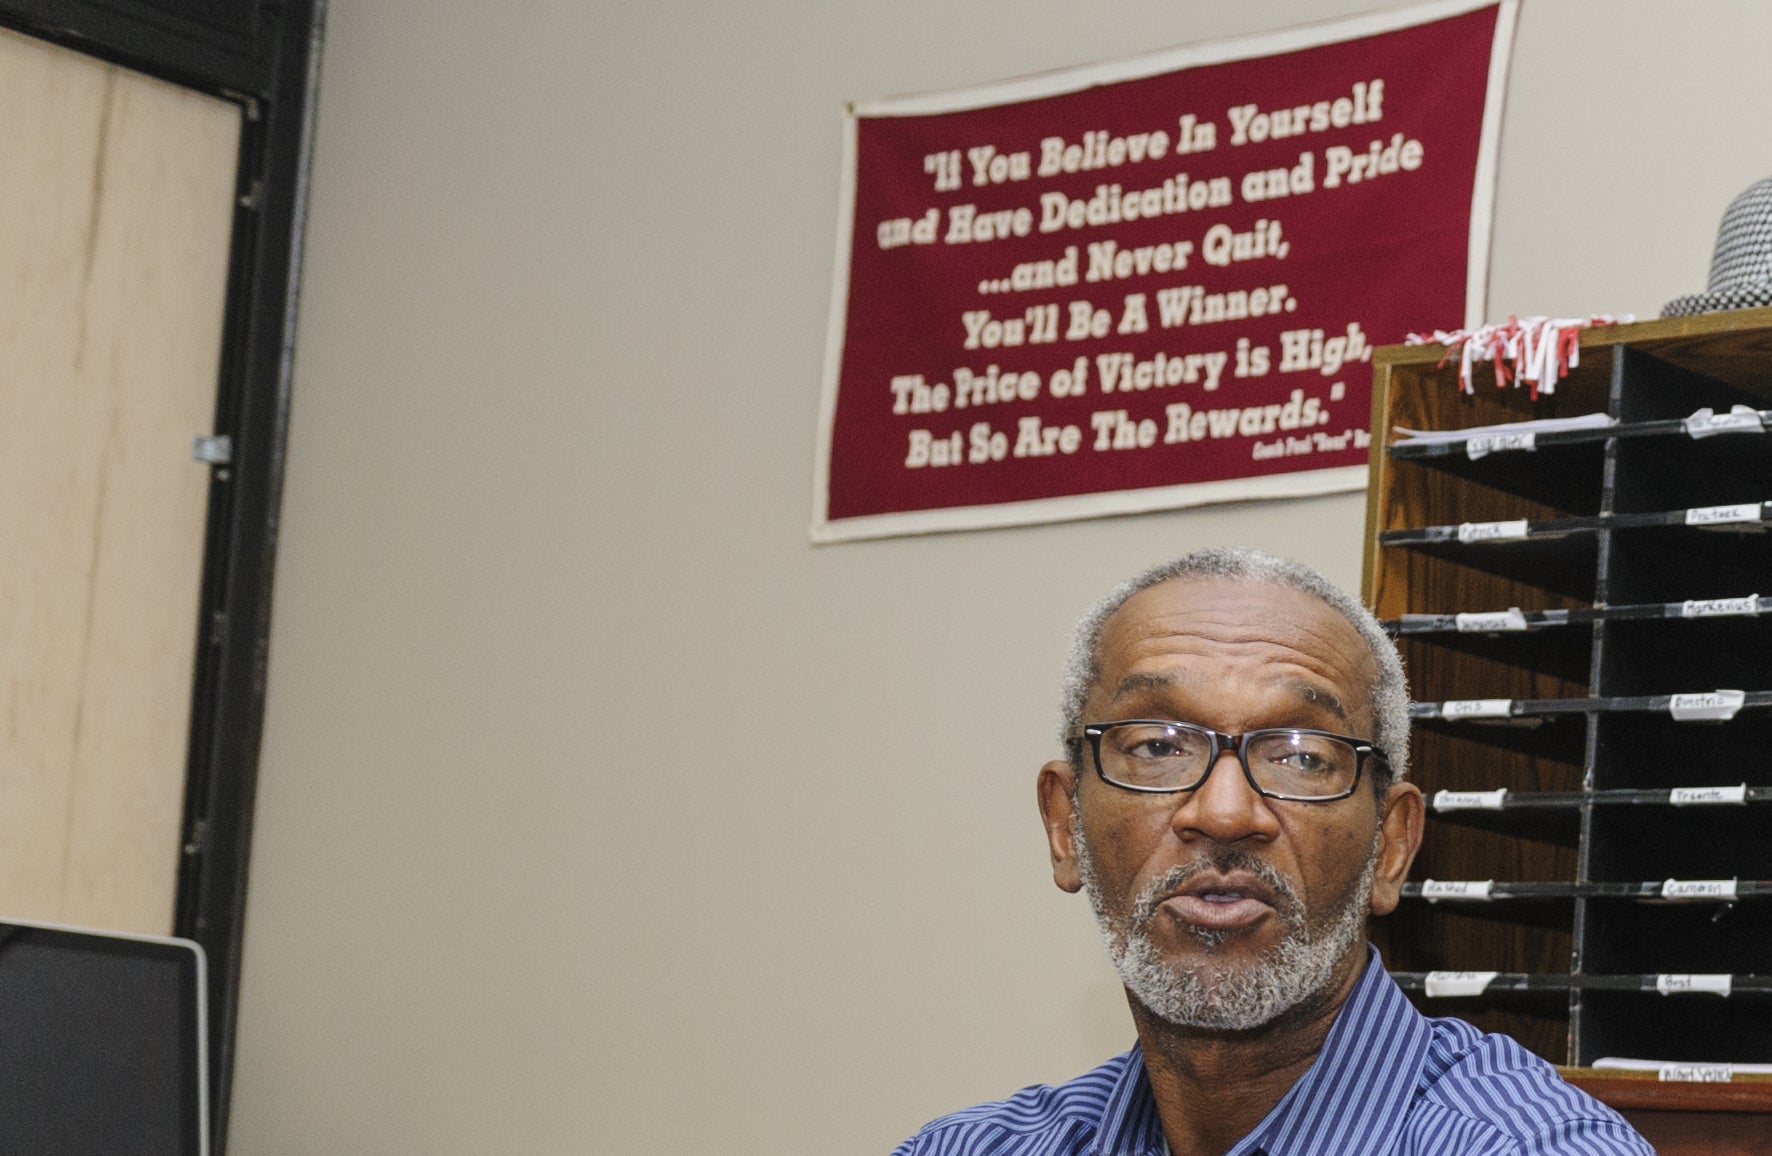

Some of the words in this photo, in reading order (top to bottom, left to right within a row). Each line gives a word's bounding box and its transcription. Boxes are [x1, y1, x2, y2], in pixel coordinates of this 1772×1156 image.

[925, 151, 961, 191] "If
[968, 146, 1030, 185] You
[1038, 131, 1169, 176] Believe
[1177, 114, 1216, 154] In
[1228, 80, 1384, 145] Yourself
[878, 209, 939, 248] and
[945, 205, 1032, 243] Have
[1039, 173, 1232, 233] Dedication
[1242, 152, 1314, 201] and
[1324, 137, 1424, 188] Pride
[979, 247, 1078, 293] ...and
[1086, 241, 1193, 282] Never
[1203, 219, 1289, 266] Quit,
[963, 306, 1058, 349] You'll
[1066, 301, 1111, 340] Be
[1118, 295, 1148, 334] A
[1158, 286, 1297, 329] Winner.
[891, 375, 949, 414] The
[954, 367, 1040, 408] Price
[1050, 357, 1088, 397] of
[1097, 352, 1227, 392] Victory
[1235, 338, 1270, 377] is
[1280, 324, 1373, 377] High,
[905, 430, 962, 467] But
[969, 426, 1007, 462] So
[1014, 417, 1081, 457] Are
[1092, 410, 1157, 451] The
[1164, 383, 1346, 443] Rewards."
